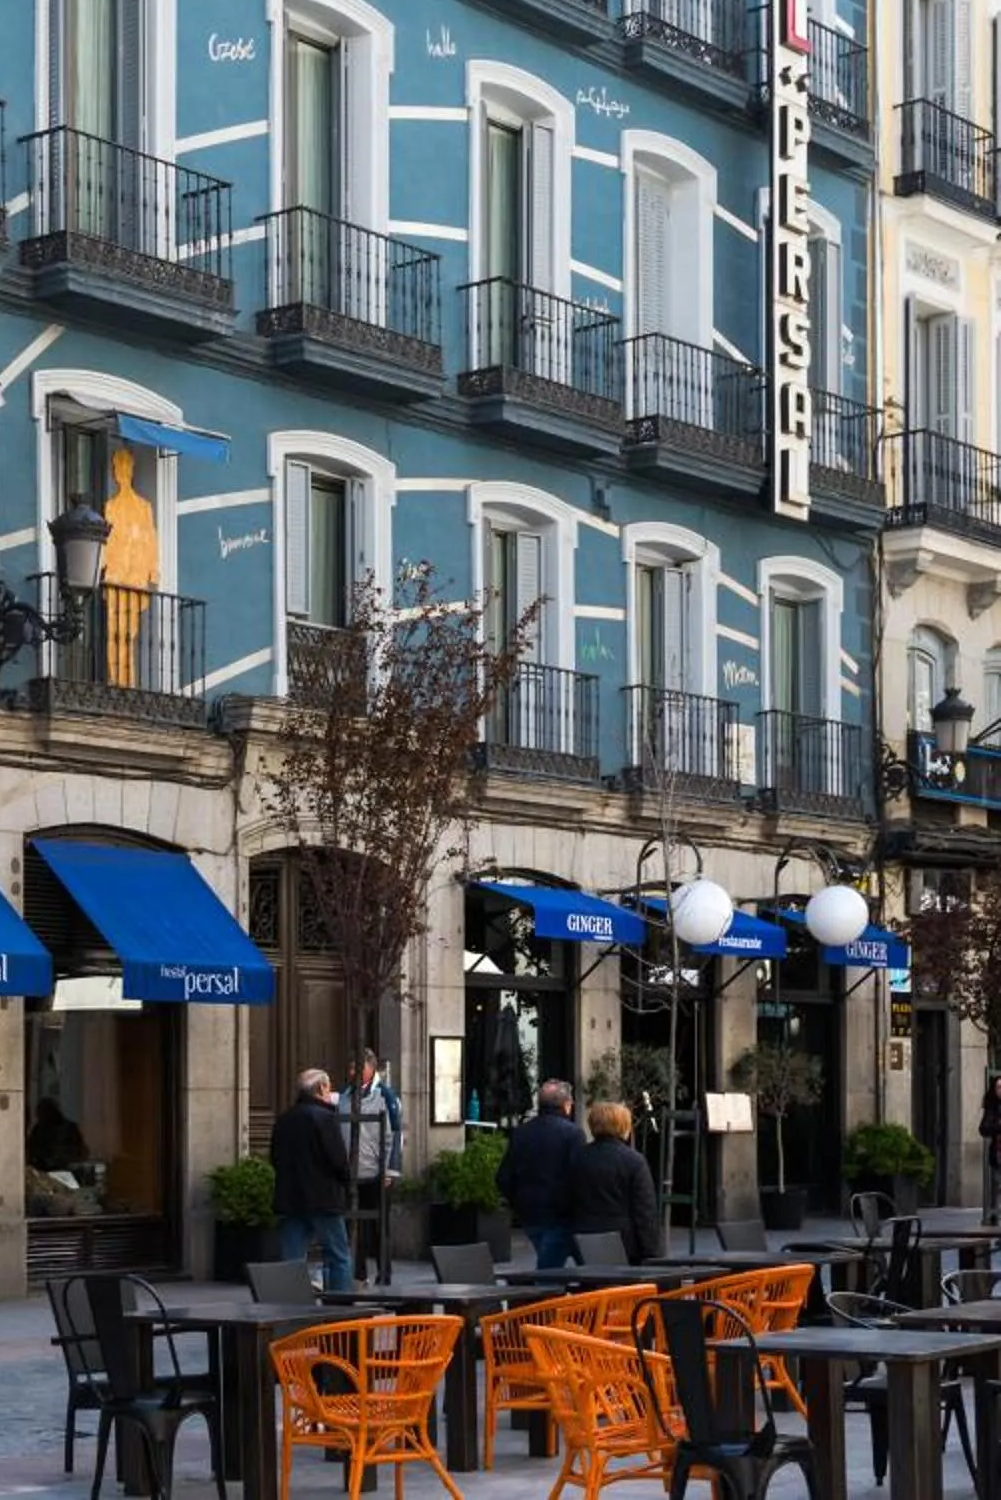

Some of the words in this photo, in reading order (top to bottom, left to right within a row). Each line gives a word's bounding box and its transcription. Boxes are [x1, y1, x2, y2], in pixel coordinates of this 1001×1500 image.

[567, 913, 613, 935] GINGER
[845, 940, 888, 962] GINGER
[160, 964, 186, 979] hostal
[183, 965, 239, 1001] persal
